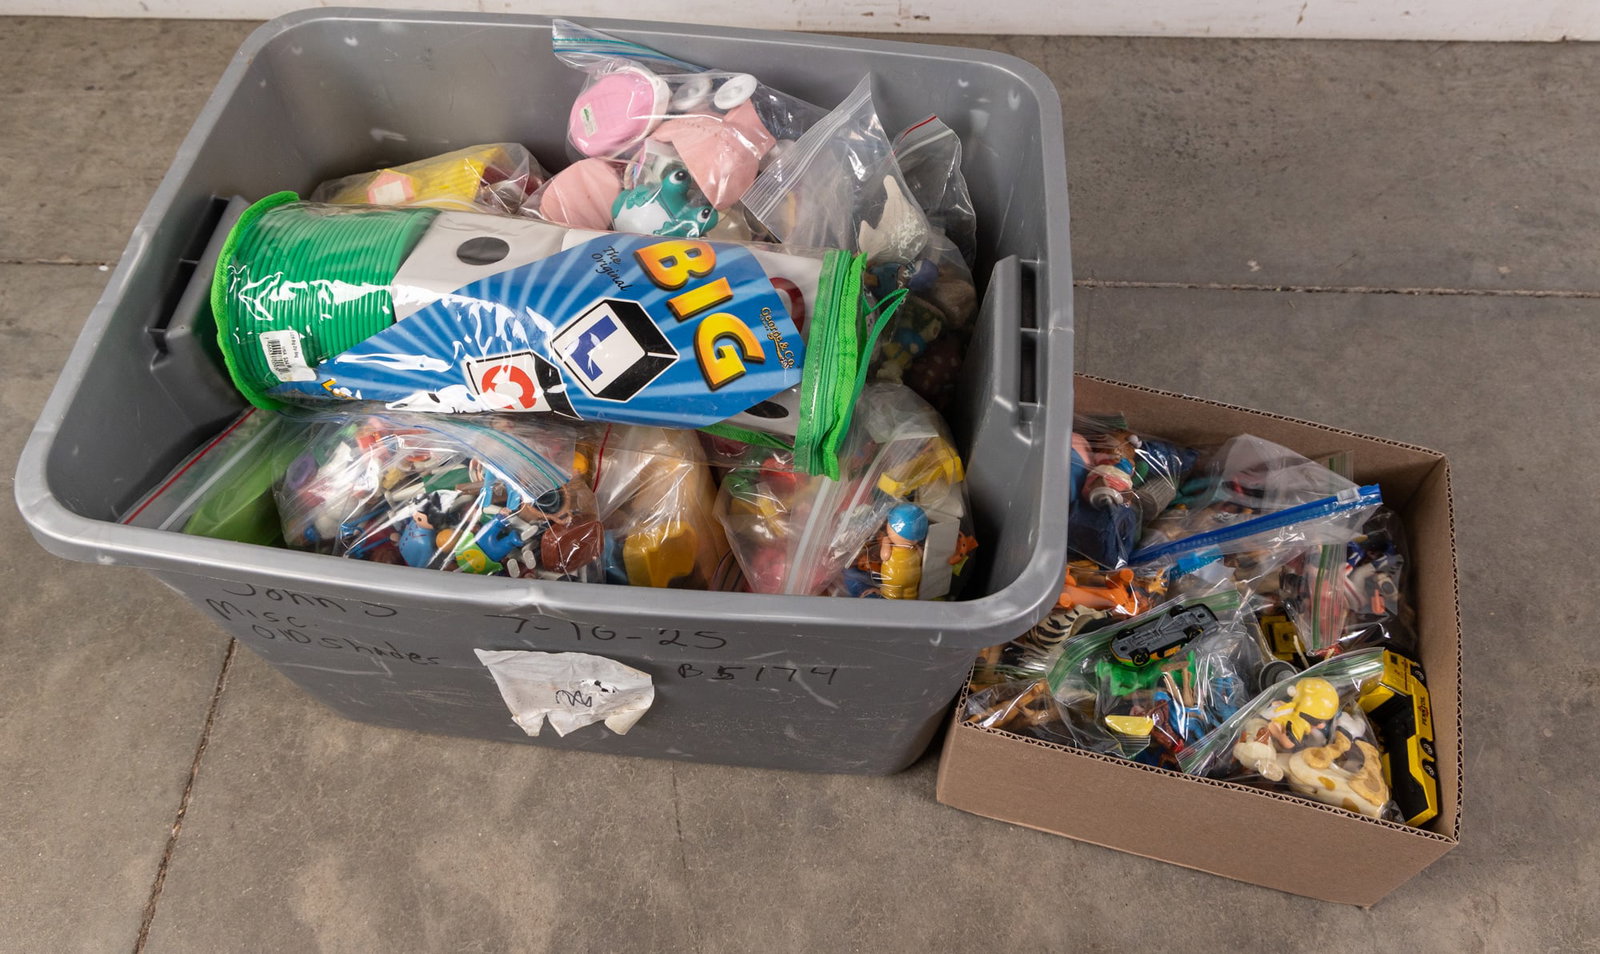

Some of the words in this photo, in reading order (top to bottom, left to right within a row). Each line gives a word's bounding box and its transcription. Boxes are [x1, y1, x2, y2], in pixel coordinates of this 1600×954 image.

[591, 253, 634, 292] Original
[603, 245, 622, 266] The
[633, 239, 766, 392] BIG
[761, 306, 783, 341] George
